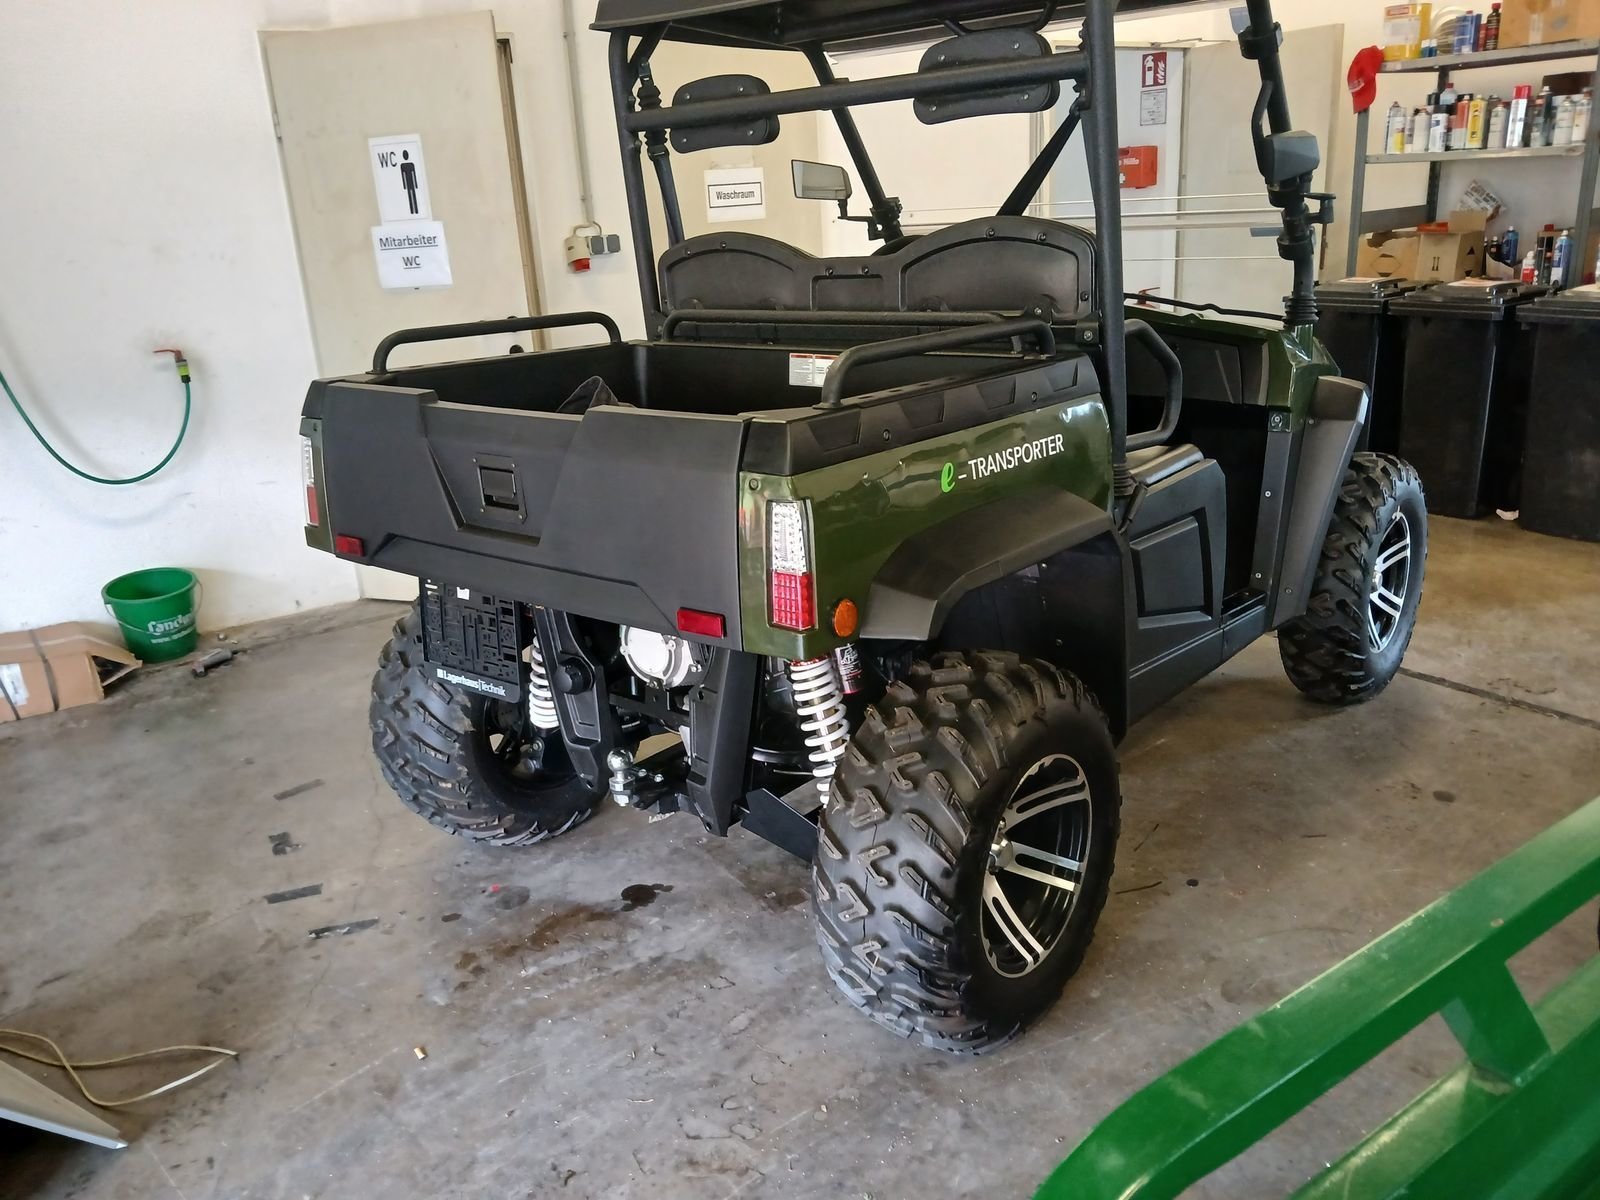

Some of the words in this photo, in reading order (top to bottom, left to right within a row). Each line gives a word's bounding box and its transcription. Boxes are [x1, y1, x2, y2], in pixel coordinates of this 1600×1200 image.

[377, 151, 398, 168] WC
[715, 190, 755, 200] Waschraum
[379, 234, 437, 249] Mitarbeiter
[402, 255, 421, 267] WC
